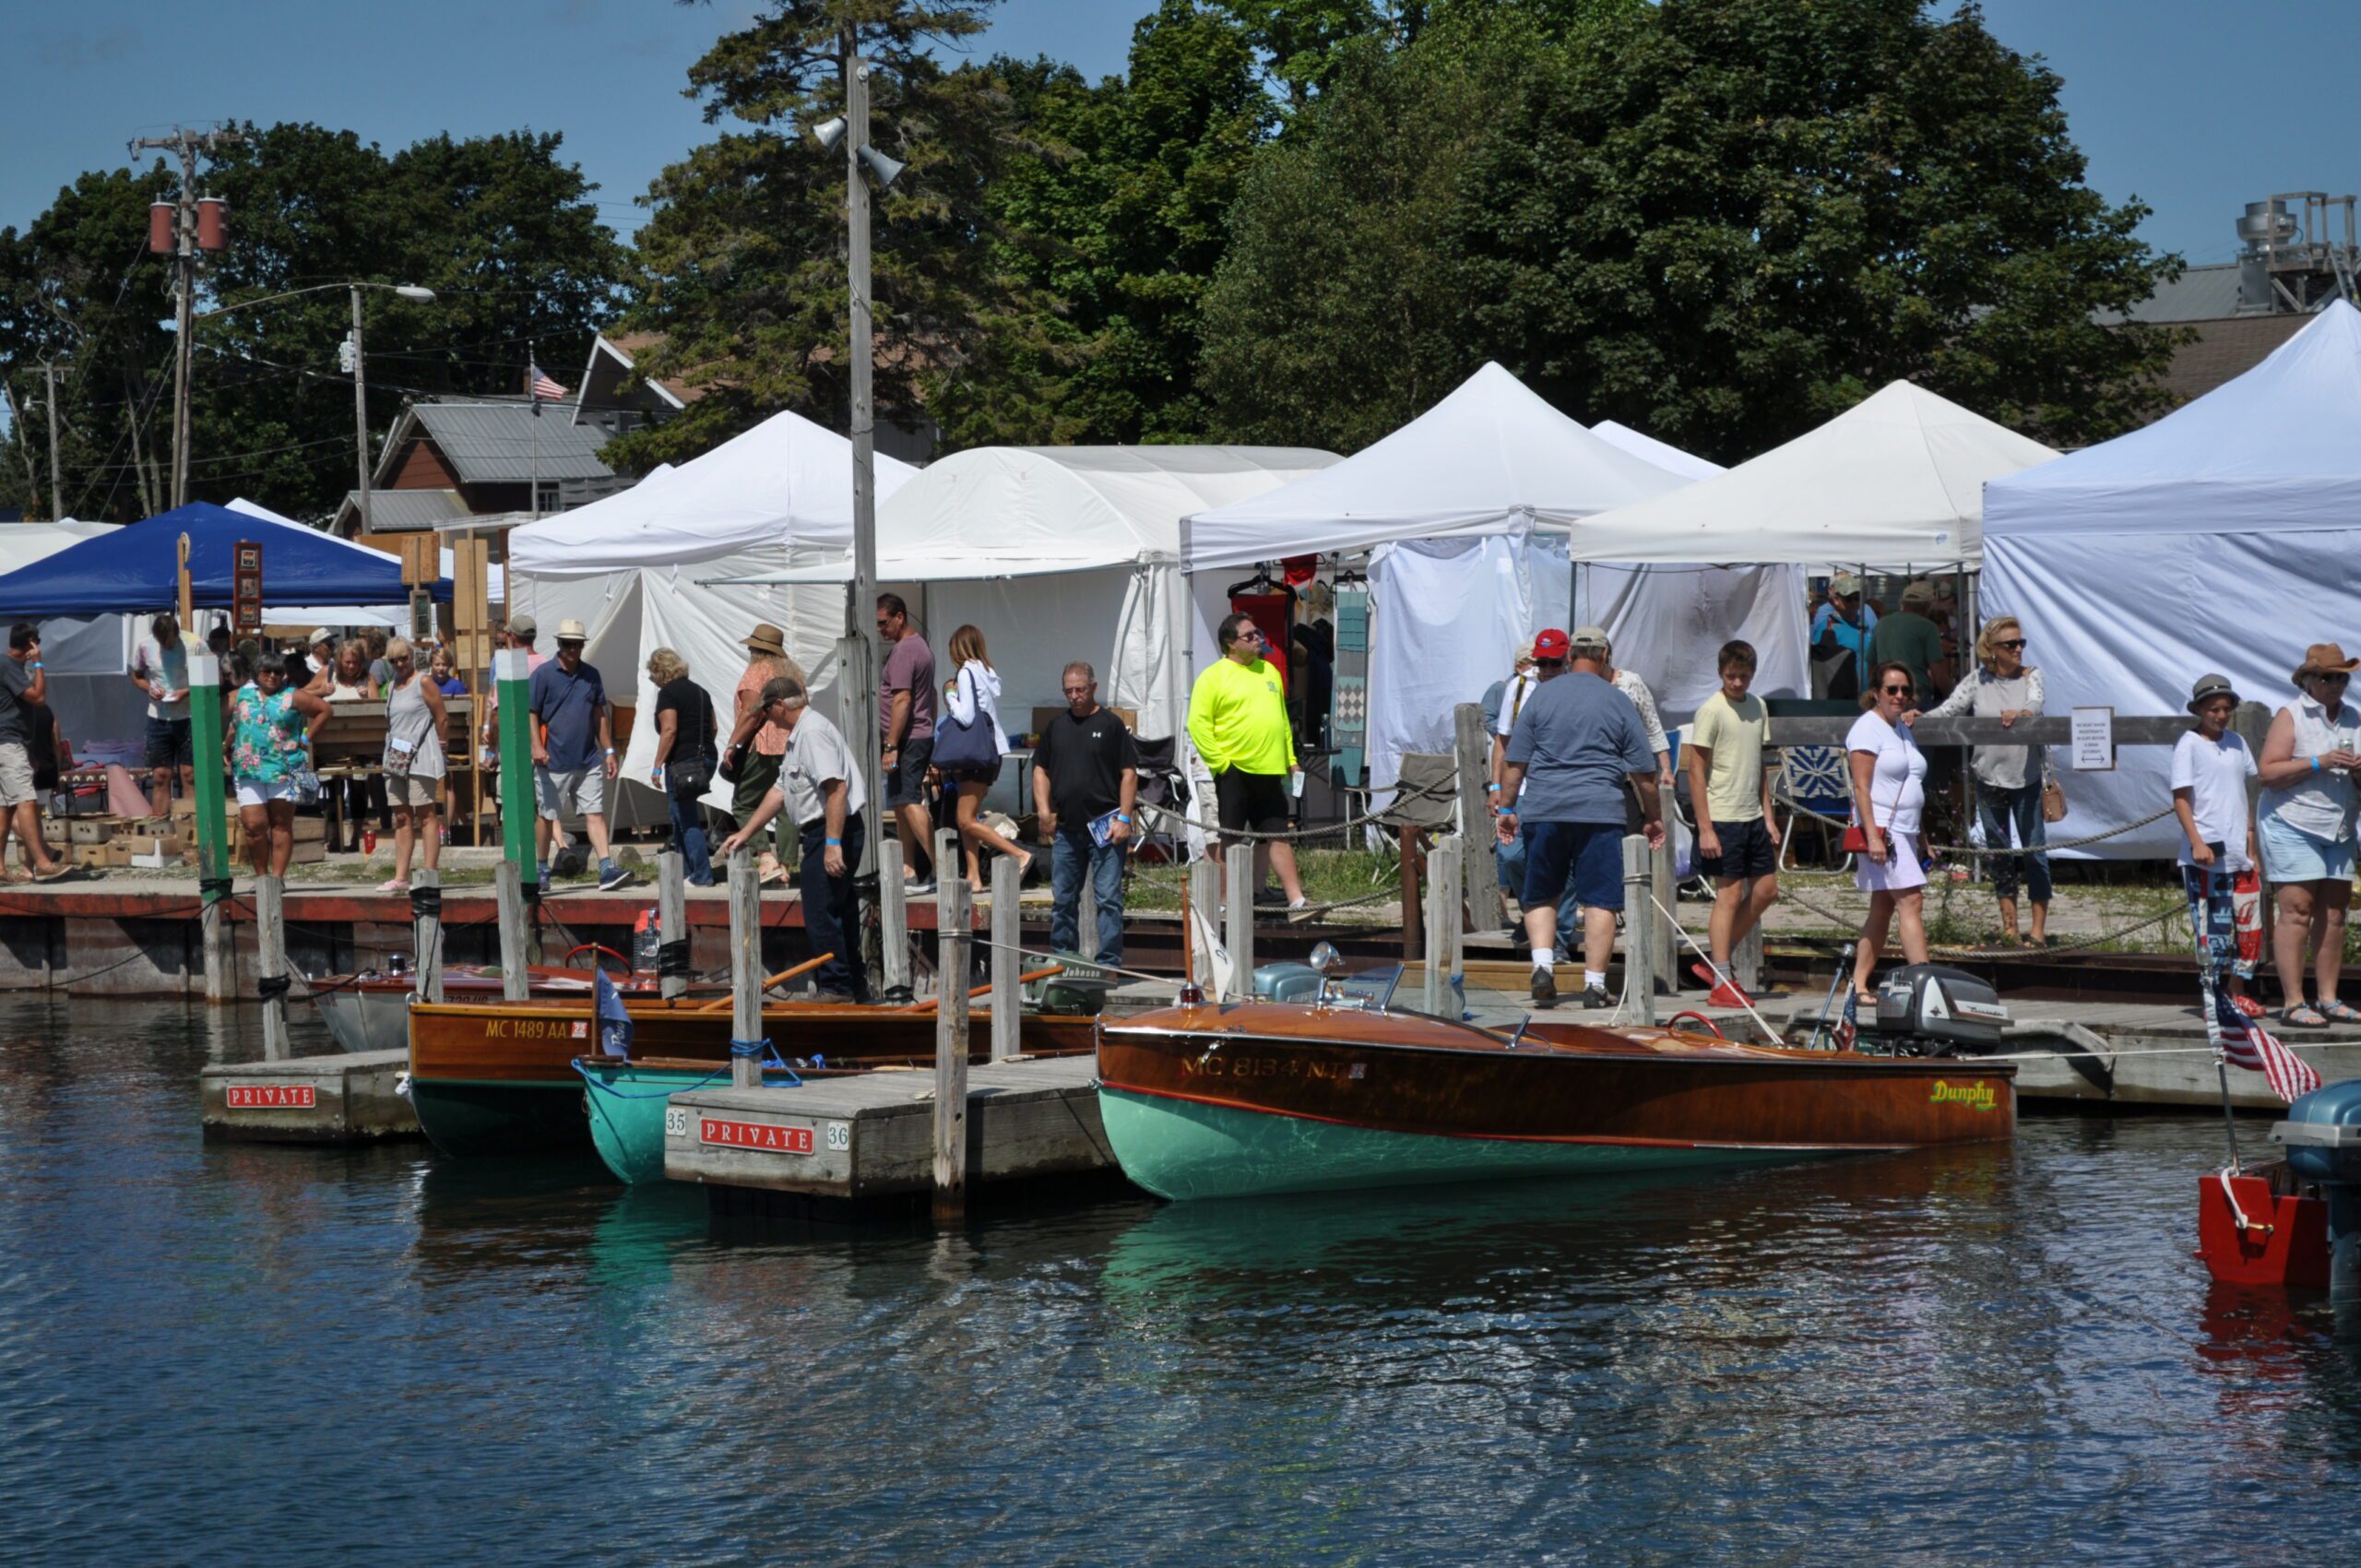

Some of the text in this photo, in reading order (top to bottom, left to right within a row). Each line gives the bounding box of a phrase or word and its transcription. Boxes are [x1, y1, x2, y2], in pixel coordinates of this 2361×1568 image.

[1062, 966, 1100, 978] Johnson
[486, 1020, 566, 1039] MC 1489 AA
[574, 1023, 586, 1034] 22
[1181, 1056, 1224, 1076] MC
[231, 1089, 311, 1105] PRIVATE
[1929, 1079, 1998, 1111] Dunphy
[667, 1112, 685, 1131] 35
[706, 1123, 809, 1149] PRIVATE
[828, 1127, 848, 1146] 36
